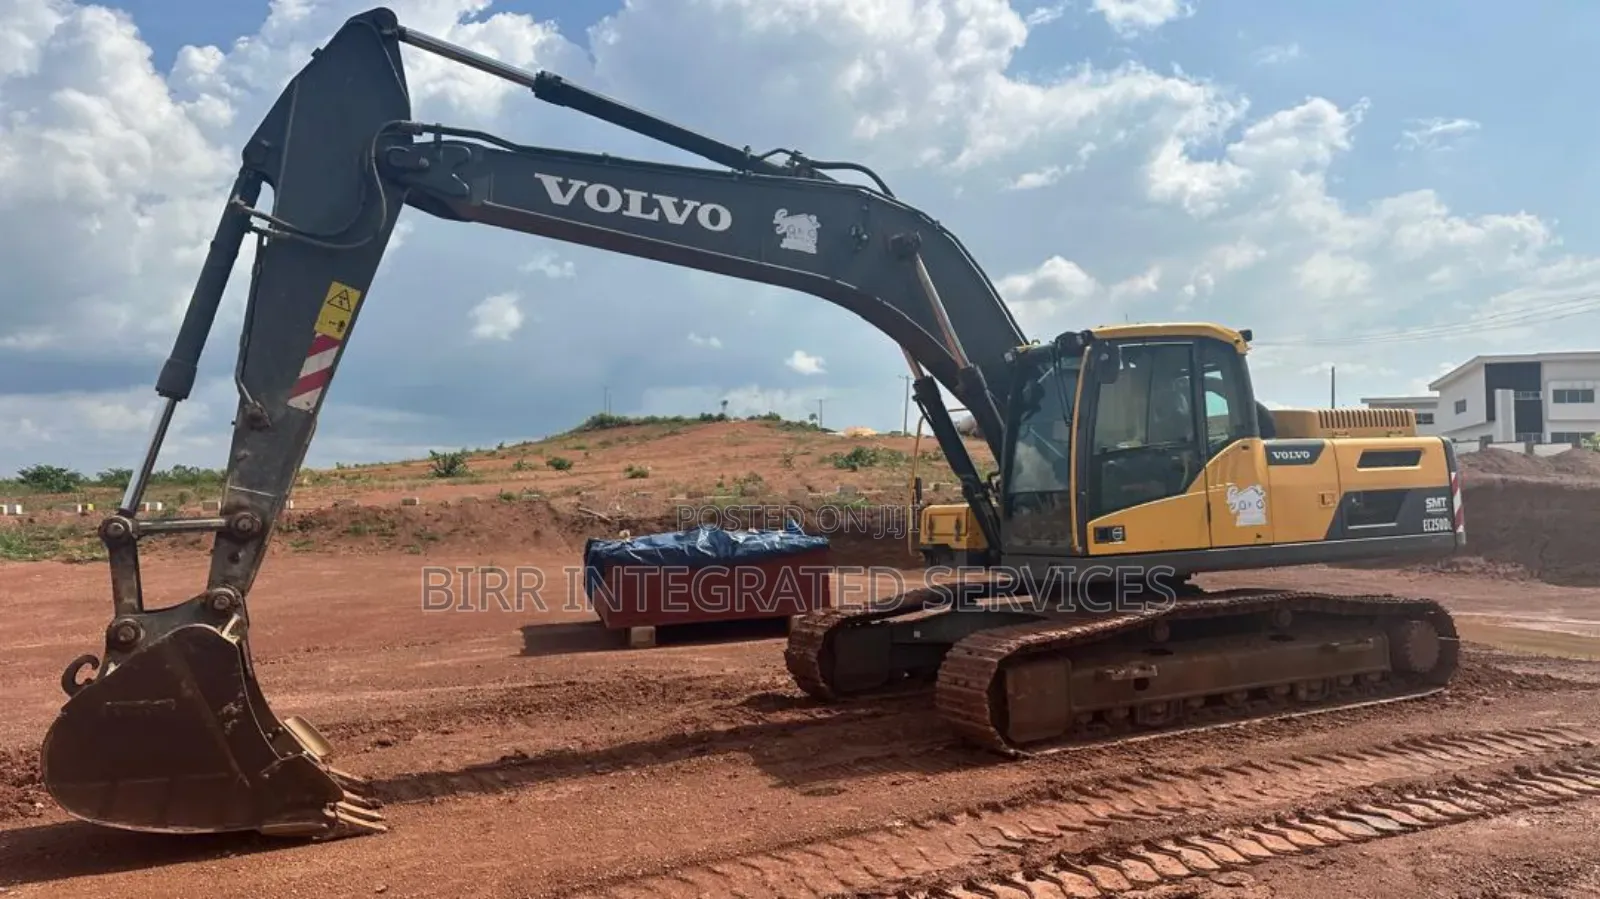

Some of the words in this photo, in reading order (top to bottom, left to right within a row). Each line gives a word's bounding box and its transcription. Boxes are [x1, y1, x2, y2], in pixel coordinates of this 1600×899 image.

[534, 172, 733, 231] VOLVO
[1271, 451, 1311, 460] VOLVO
[1425, 497, 1447, 509] SMT
